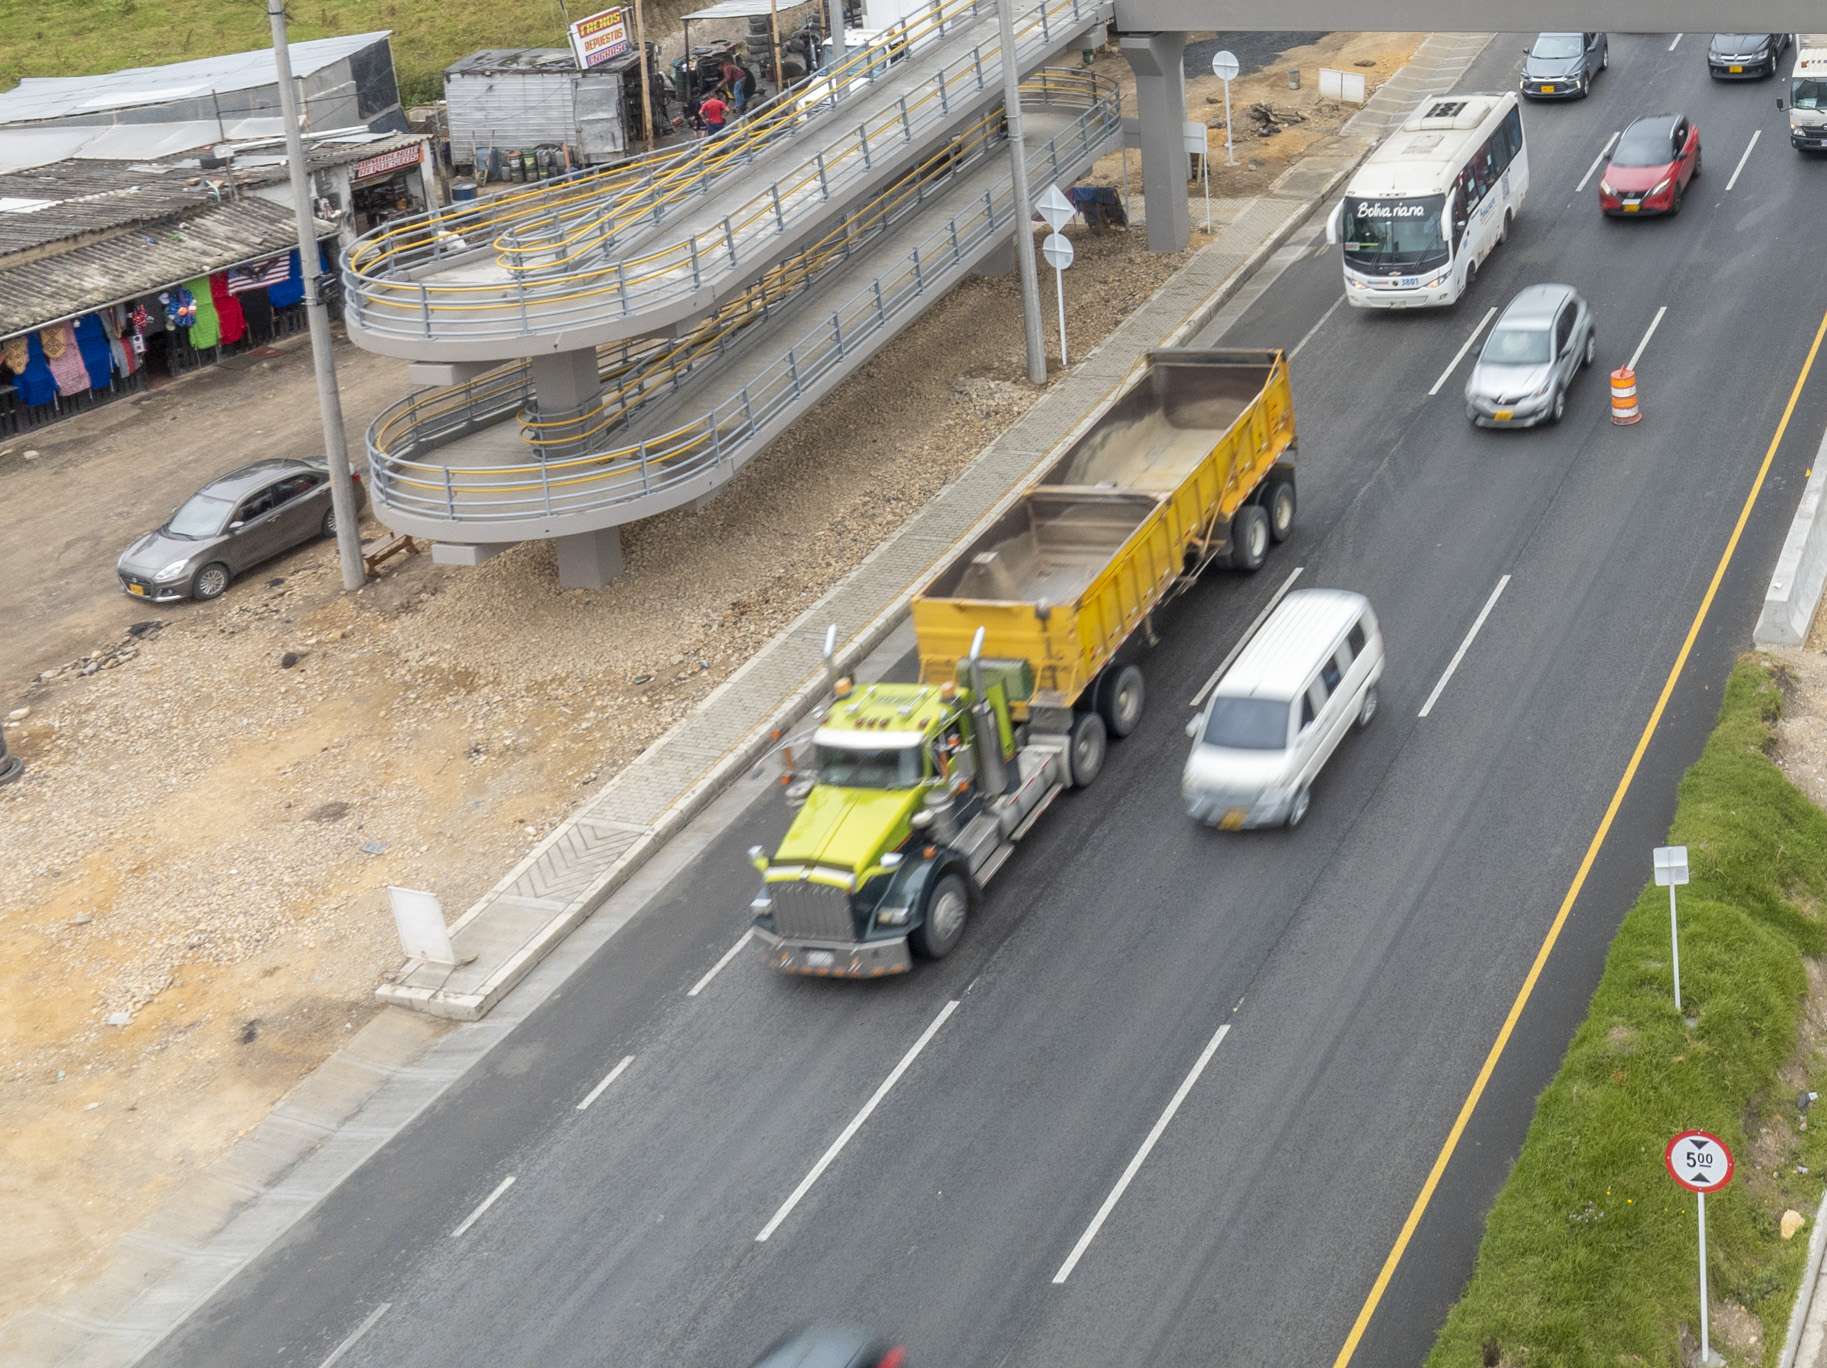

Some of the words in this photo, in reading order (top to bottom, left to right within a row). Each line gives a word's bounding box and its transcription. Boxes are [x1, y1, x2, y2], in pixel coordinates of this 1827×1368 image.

[580, 12, 620, 36] FRENOS
[585, 28, 623, 52] REPUESTOS
[588, 43, 628, 65] ENGRASE
[359, 155, 419, 175] REPUESTOS
[1401, 278, 1419, 286] 3801
